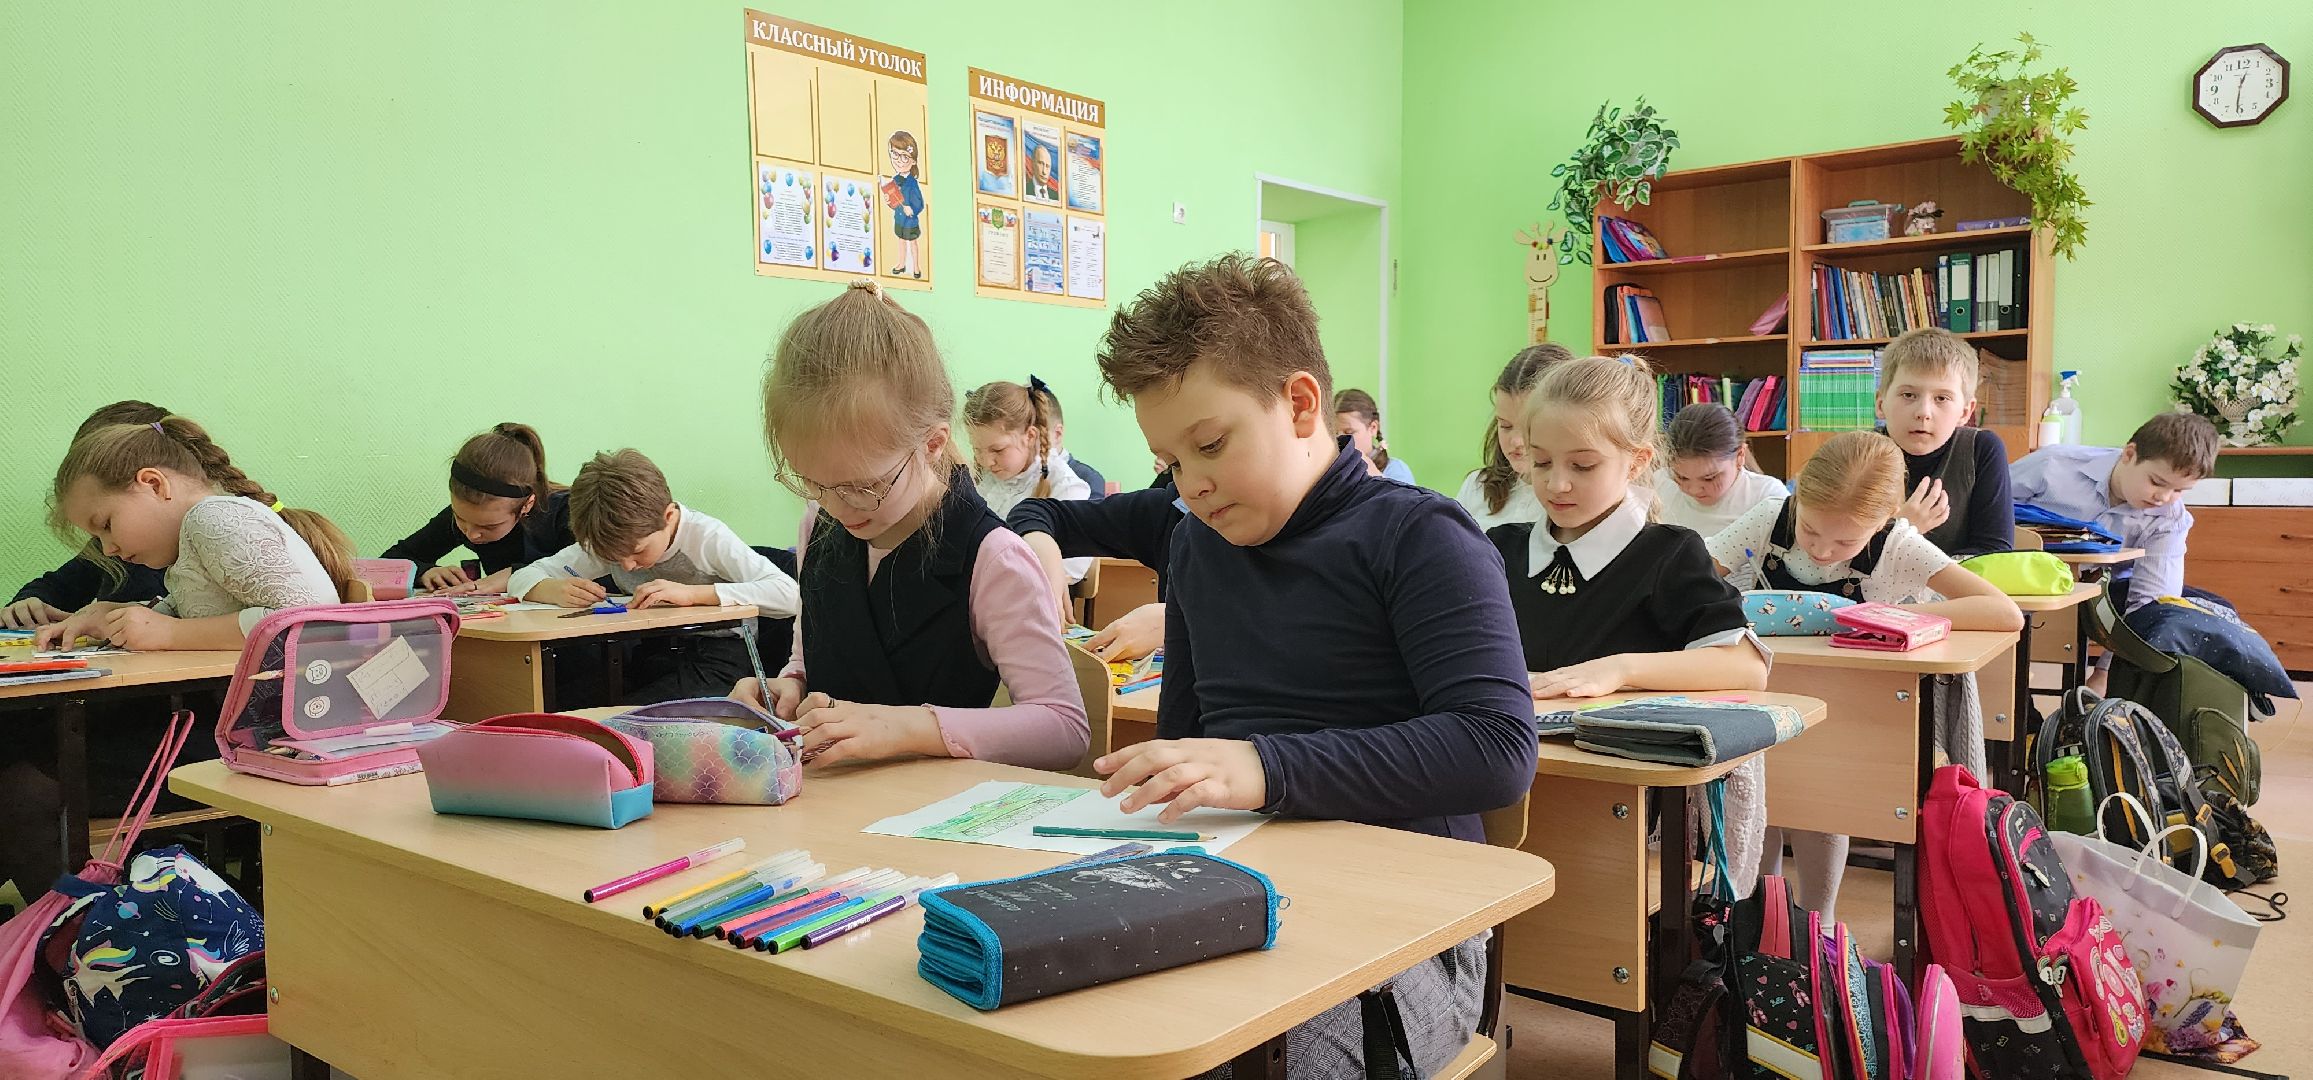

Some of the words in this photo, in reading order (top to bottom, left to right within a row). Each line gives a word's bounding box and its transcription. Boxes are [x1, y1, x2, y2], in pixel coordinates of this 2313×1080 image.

[752, 19, 855, 61] КЛАССНЫЙ
[858, 46, 923, 78] УГОЛОК
[2225, 64, 2233, 72] 11
[2237, 59, 2251, 70] 12
[2265, 68, 2271, 76] 2
[2213, 74, 2223, 82] 10
[2265, 78, 2274, 88] 3
[2210, 85, 2219, 95] 9
[979, 75, 1099, 123] ИНФОРМАЦИЯ
[2224, 105, 2230, 113] 7
[2251, 102, 2258, 110] 5
